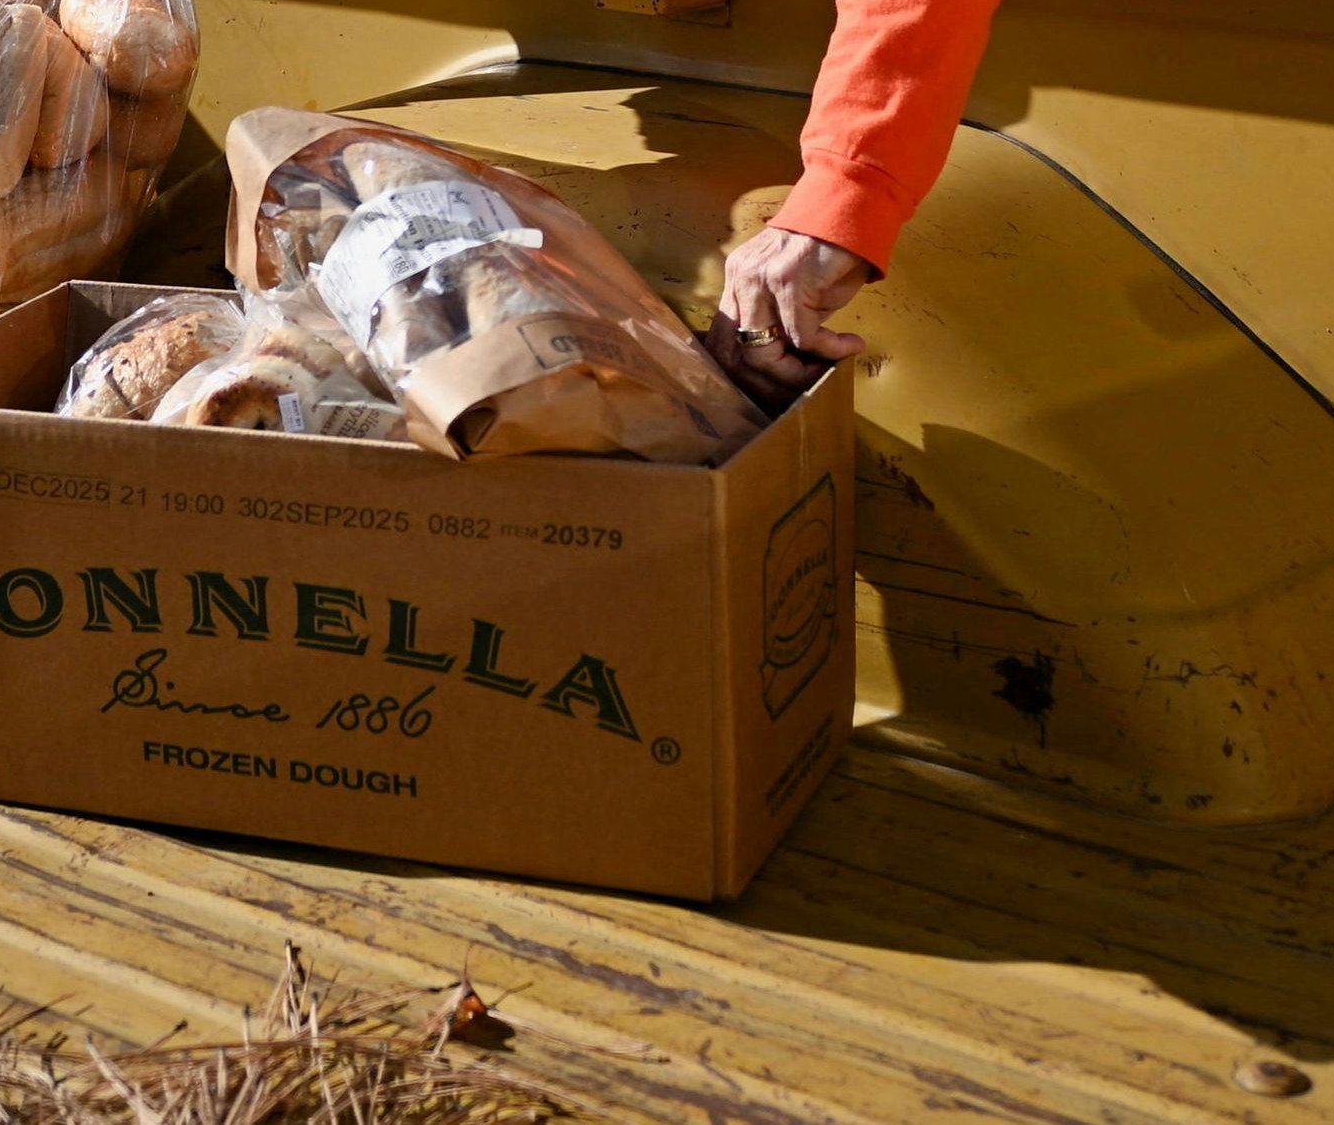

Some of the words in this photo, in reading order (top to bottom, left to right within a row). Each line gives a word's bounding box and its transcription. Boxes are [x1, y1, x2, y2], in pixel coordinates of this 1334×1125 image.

[120, 484, 148, 508] 21
[162, 487, 225, 516] 19:00
[238, 496, 410, 533] 302SEP2025
[427, 512, 492, 540] 0882
[499, 523, 540, 539] ITEM
[542, 523, 624, 551] 20379
[100, 647, 291, 724] Since
[315, 685, 437, 738] 1886
[142, 740, 278, 779] FROZEN
[288, 760, 419, 798] DOUGH
